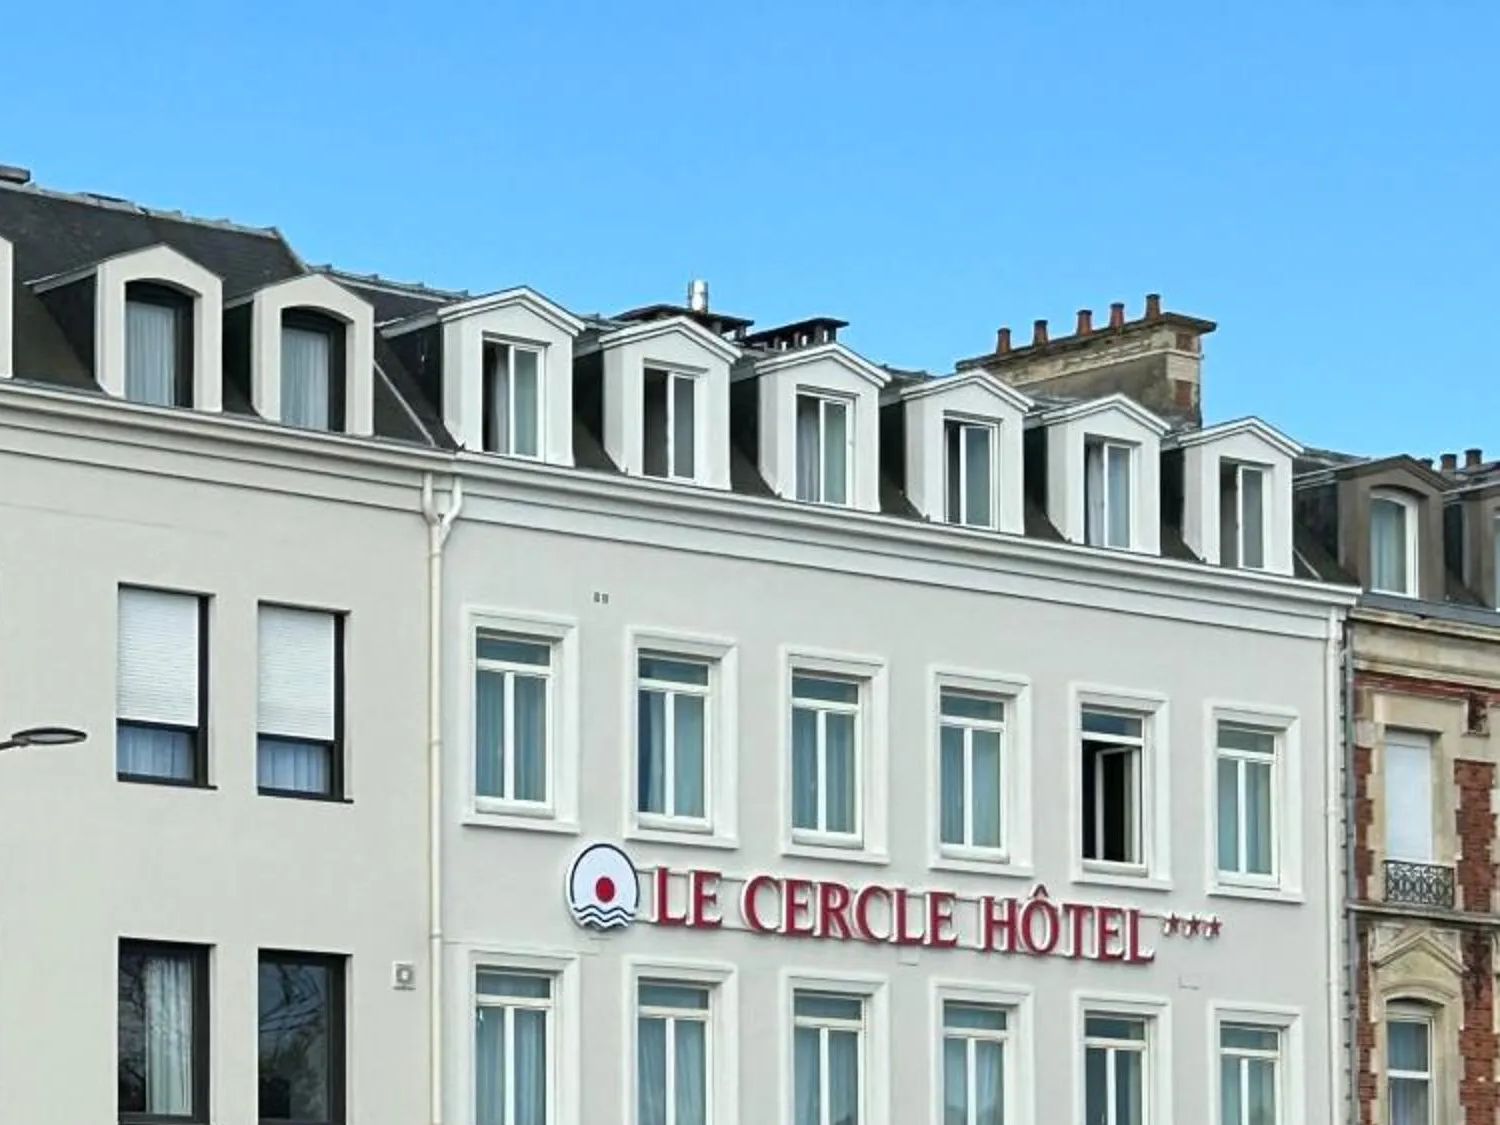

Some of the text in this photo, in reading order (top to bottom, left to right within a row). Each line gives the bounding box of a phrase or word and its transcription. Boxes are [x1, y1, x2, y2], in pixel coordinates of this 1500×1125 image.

[649, 865, 1156, 965] LE CERCLE HÔTEL
